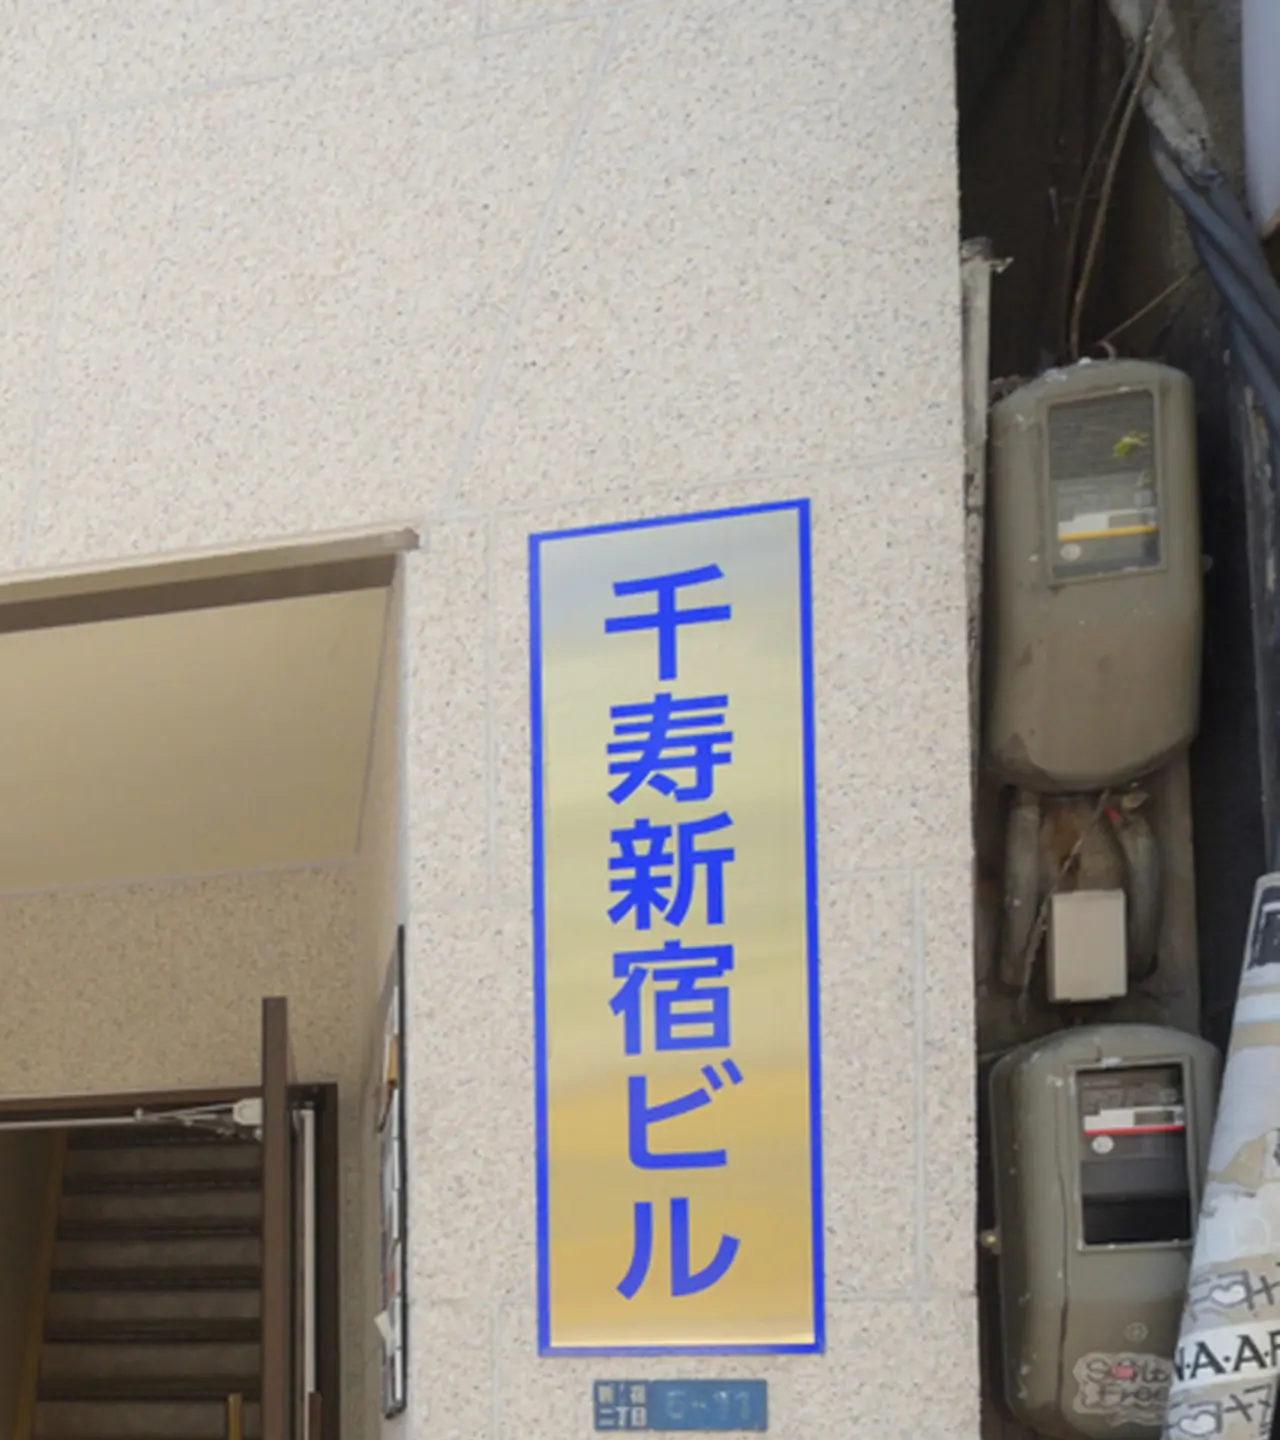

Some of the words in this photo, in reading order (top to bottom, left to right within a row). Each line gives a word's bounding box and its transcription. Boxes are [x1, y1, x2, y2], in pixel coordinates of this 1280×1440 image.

[604, 563, 742, 1300] 千寿新宿ビル
